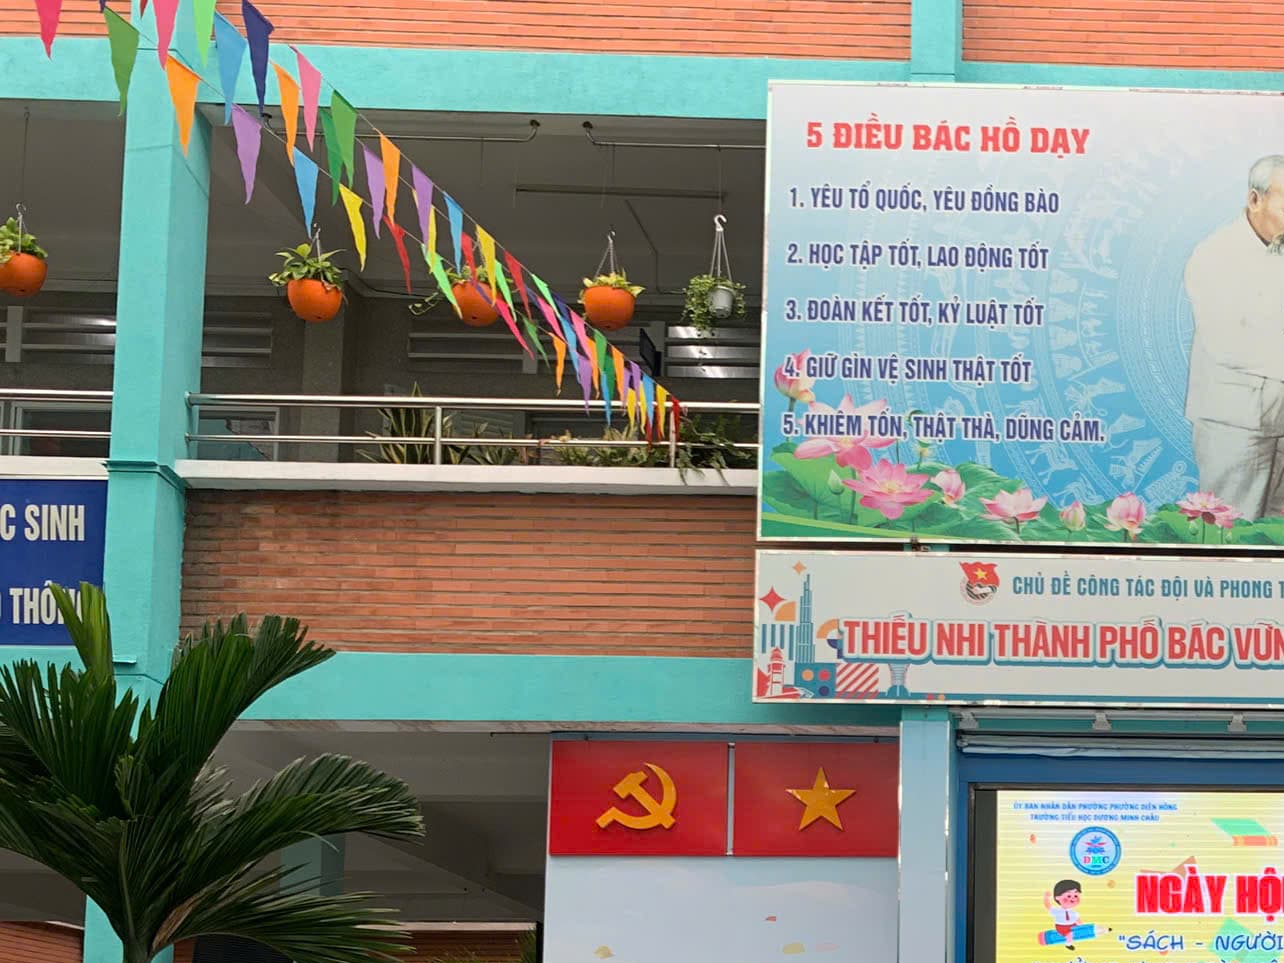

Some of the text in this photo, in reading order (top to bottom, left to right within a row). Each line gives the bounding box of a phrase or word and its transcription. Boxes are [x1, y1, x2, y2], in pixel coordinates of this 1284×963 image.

[806, 112, 1090, 158] 5 ĐIỀU BÁC HỒ DẠY
[790, 181, 1059, 213] 1. YÊU TỔ QUỐC, YÊU ĐỒNG BÀO
[787, 238, 1049, 273] 2. HỌC TẬP TỐT, LAO ĐỘNG TỐT
[786, 294, 1044, 329] 3. ĐOÀN KẾT TỐT, KỶ LUẬT TỐT
[784, 353, 1032, 386] 4. GIỮ GÌN VỆ SINH THẬT TỐT
[783, 410, 1105, 443] 5. KHIÊM TỐN, THẬT THÀ, DŨNG CẢM.
[24, 504, 85, 541] SINH
[1012, 571, 1045, 595] CHỦ
[1051, 570, 1071, 596] ĐỀ
[1077, 574, 1120, 596] CÔNG
[1125, 574, 1155, 597] TÁC
[1161, 575, 1188, 598] ĐỘI
[1194, 576, 1214, 598] VÀ
[1220, 580, 1273, 599] PHONG
[844, 613, 925, 656] THIẾU
[936, 623, 985, 657] NHI
[994, 620, 1090, 658] THÀNH
[1100, 619, 1159, 660] PHỐ
[1167, 622, 1225, 660] BÁC
[1135, 865, 1228, 915] NGÀY
[1215, 935, 1283, 951] NGƯỜI
